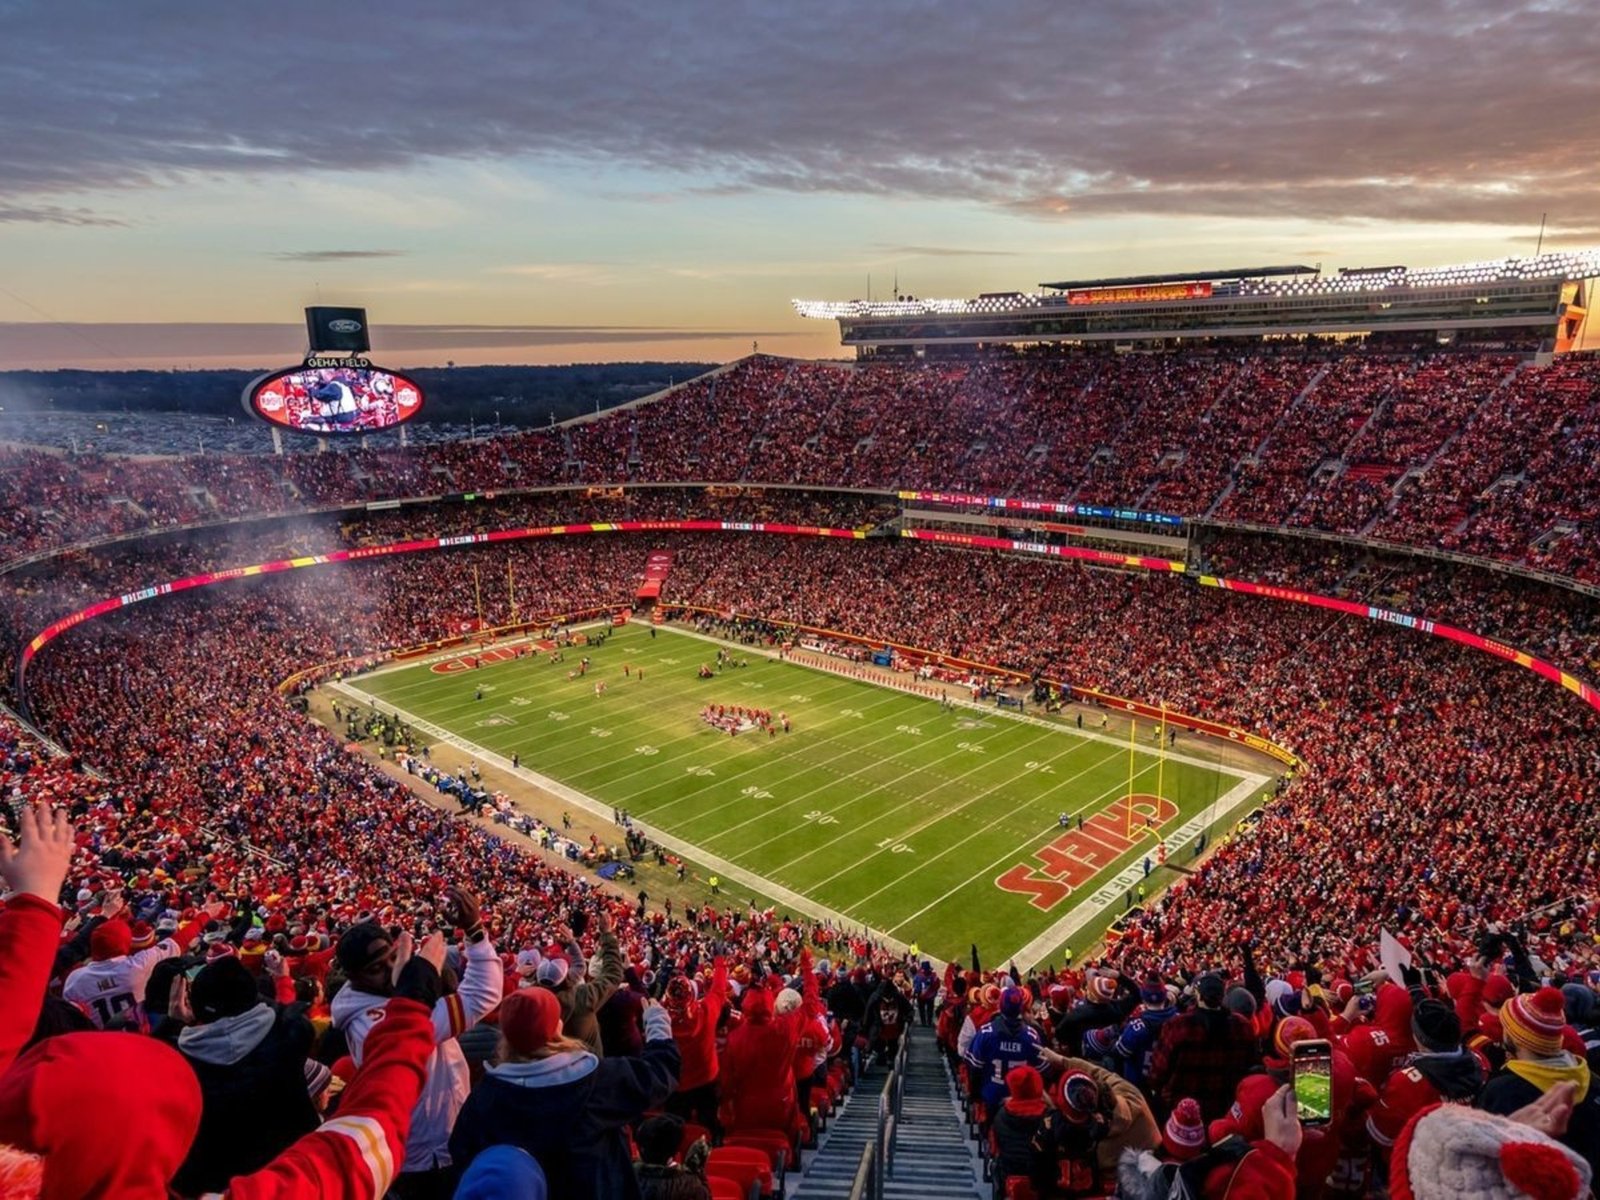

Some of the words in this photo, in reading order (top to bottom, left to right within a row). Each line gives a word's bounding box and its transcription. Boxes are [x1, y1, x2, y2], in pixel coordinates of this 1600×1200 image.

[308, 358, 338, 367] GEHA
[340, 358, 368, 367] FIELD
[803, 810, 834, 824] 20
[875, 838, 907, 853] 10
[995, 794, 1179, 912] CHIEFS
[1112, 876, 1133, 890] OF
[1091, 890, 1115, 905] US
[97, 975, 118, 991] HILL
[1370, 1030, 1390, 1046] 25
